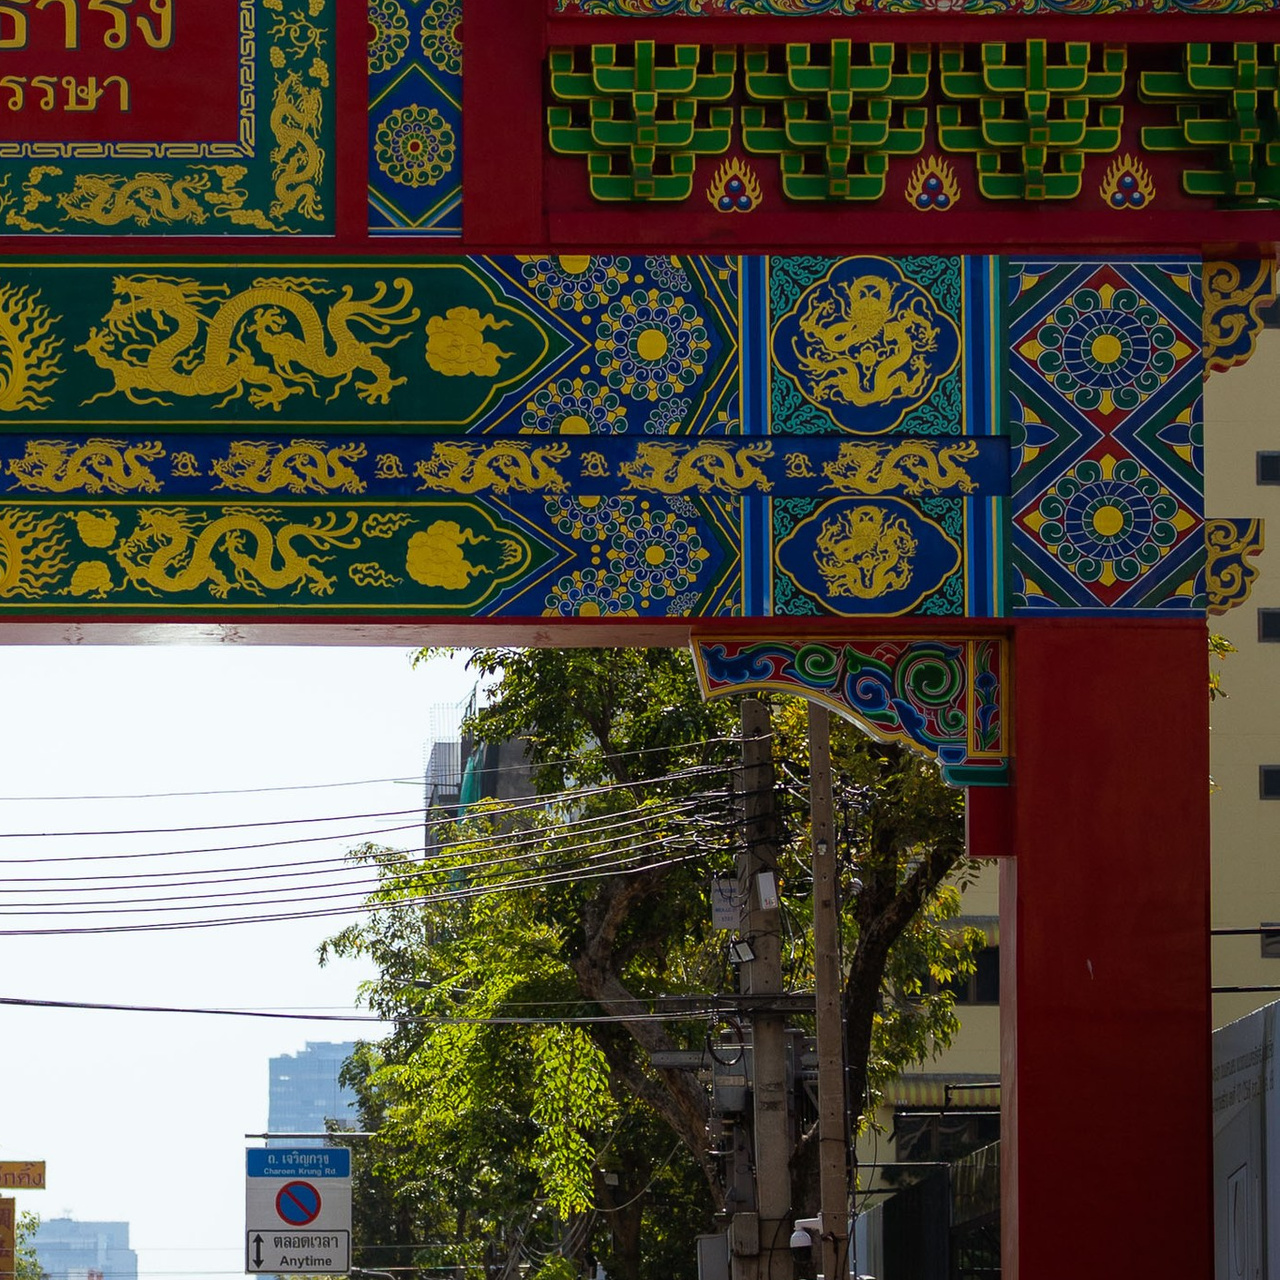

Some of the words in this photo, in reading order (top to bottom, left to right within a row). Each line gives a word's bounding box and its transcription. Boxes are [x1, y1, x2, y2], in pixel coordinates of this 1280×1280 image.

[282, 1151, 329, 1168] เจริญกรุง
[299, 1168, 322, 1176] Krung
[273, 1236, 338, 1249] ตลอดเวลา
[280, 1256, 332, 1268] Anytime
